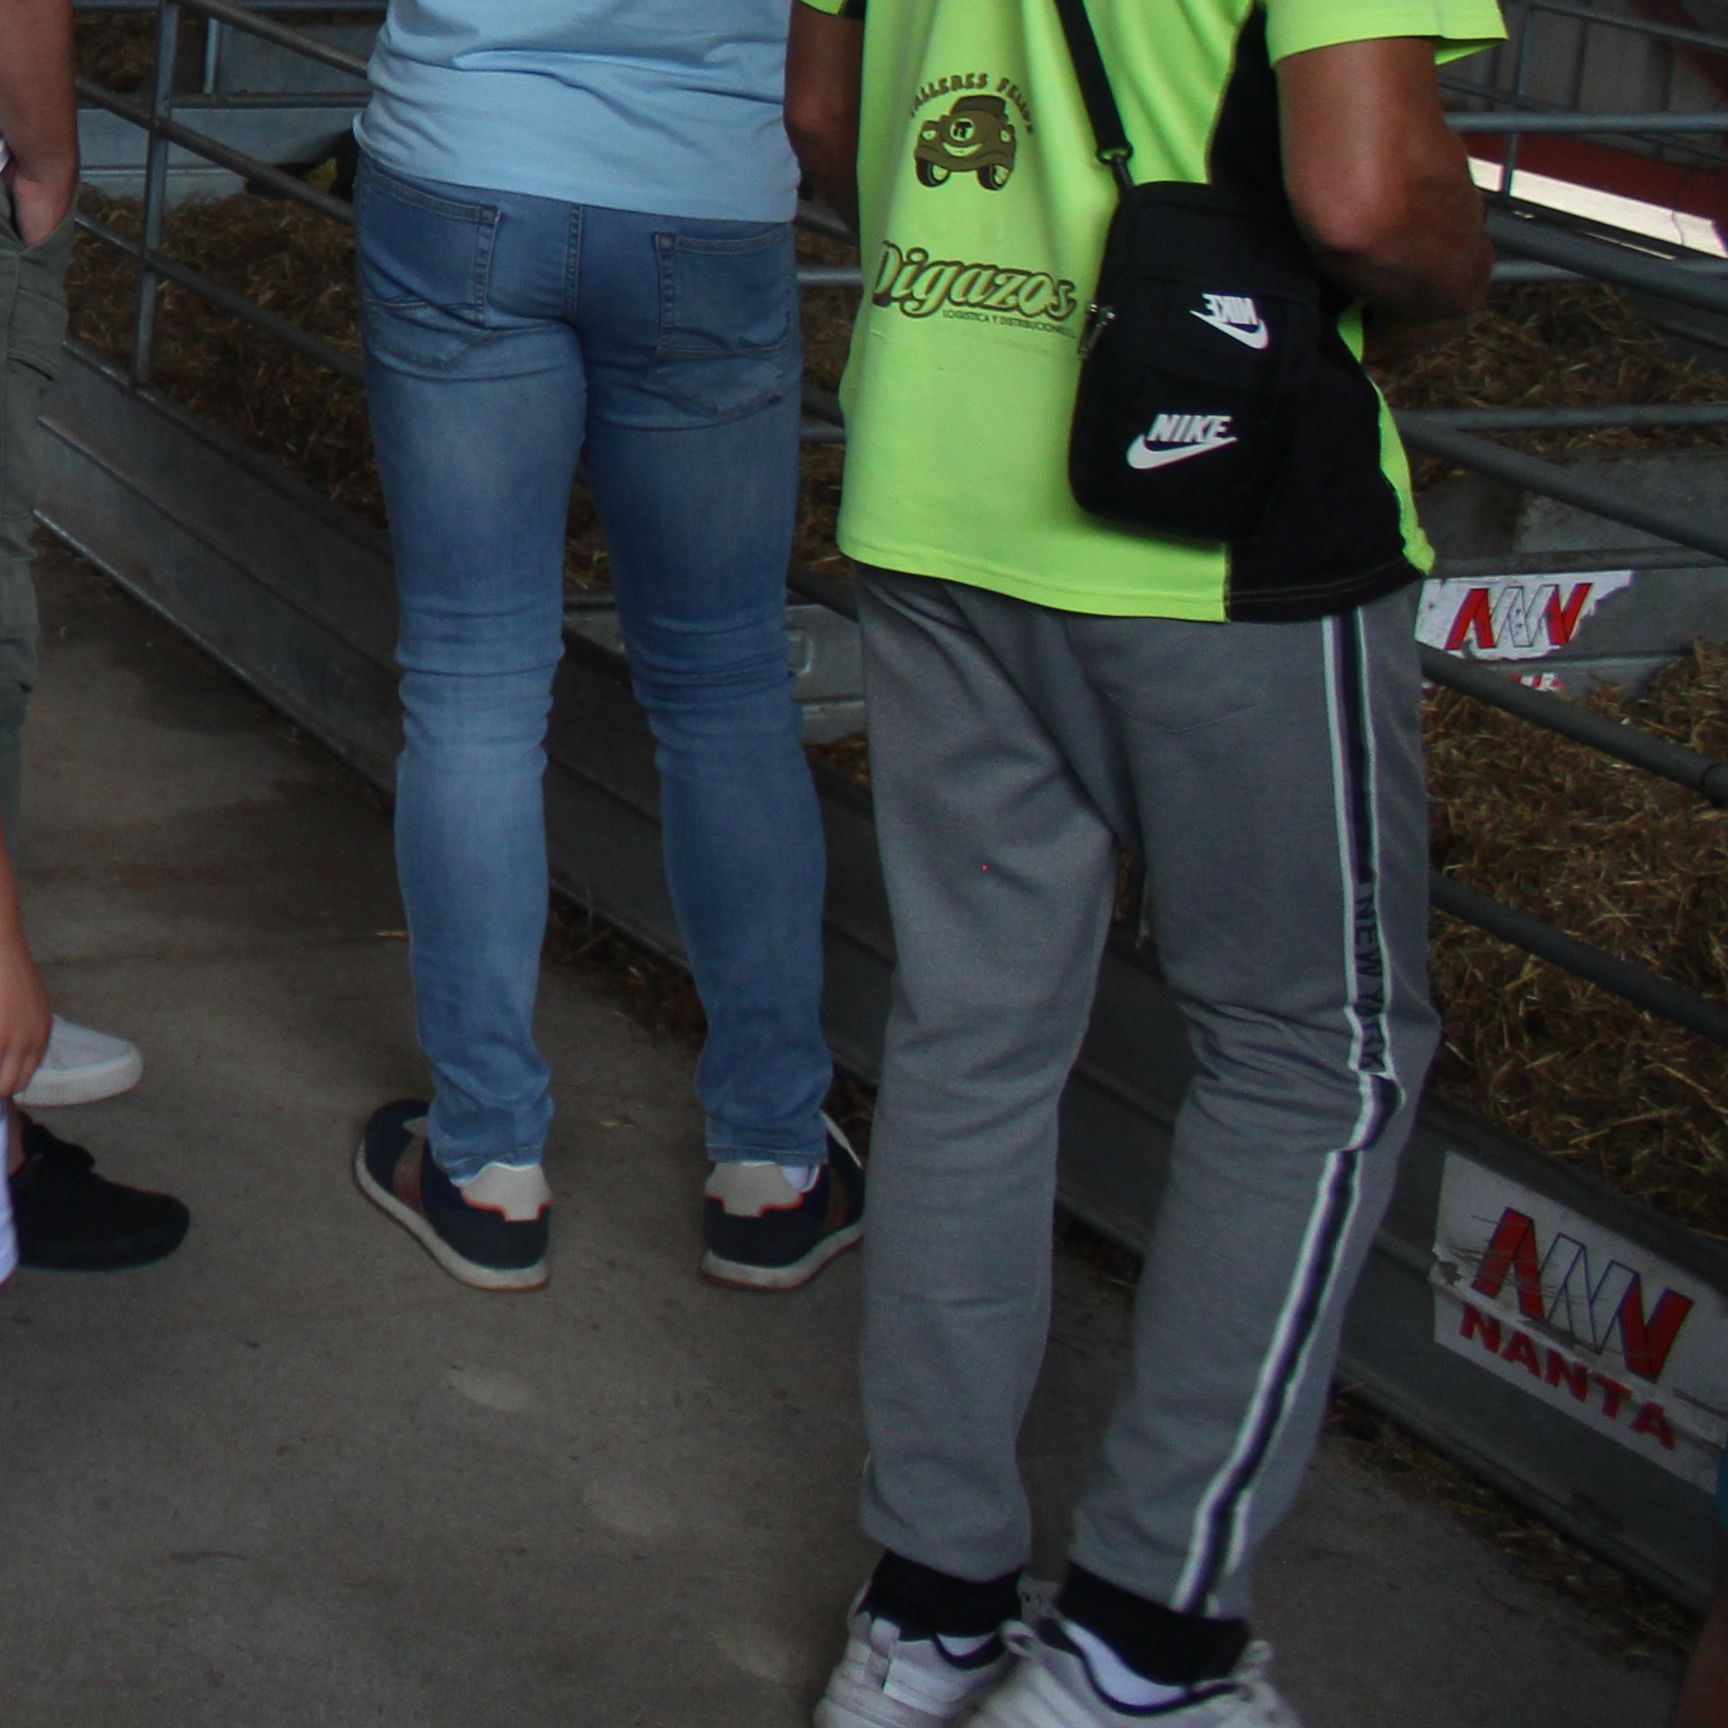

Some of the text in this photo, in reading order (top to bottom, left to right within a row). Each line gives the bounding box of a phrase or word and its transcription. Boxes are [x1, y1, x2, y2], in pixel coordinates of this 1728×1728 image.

[871, 239, 1078, 321] Digazos
[1146, 412, 1234, 444] NIKE
[1458, 1300, 1678, 1453] NANTA
